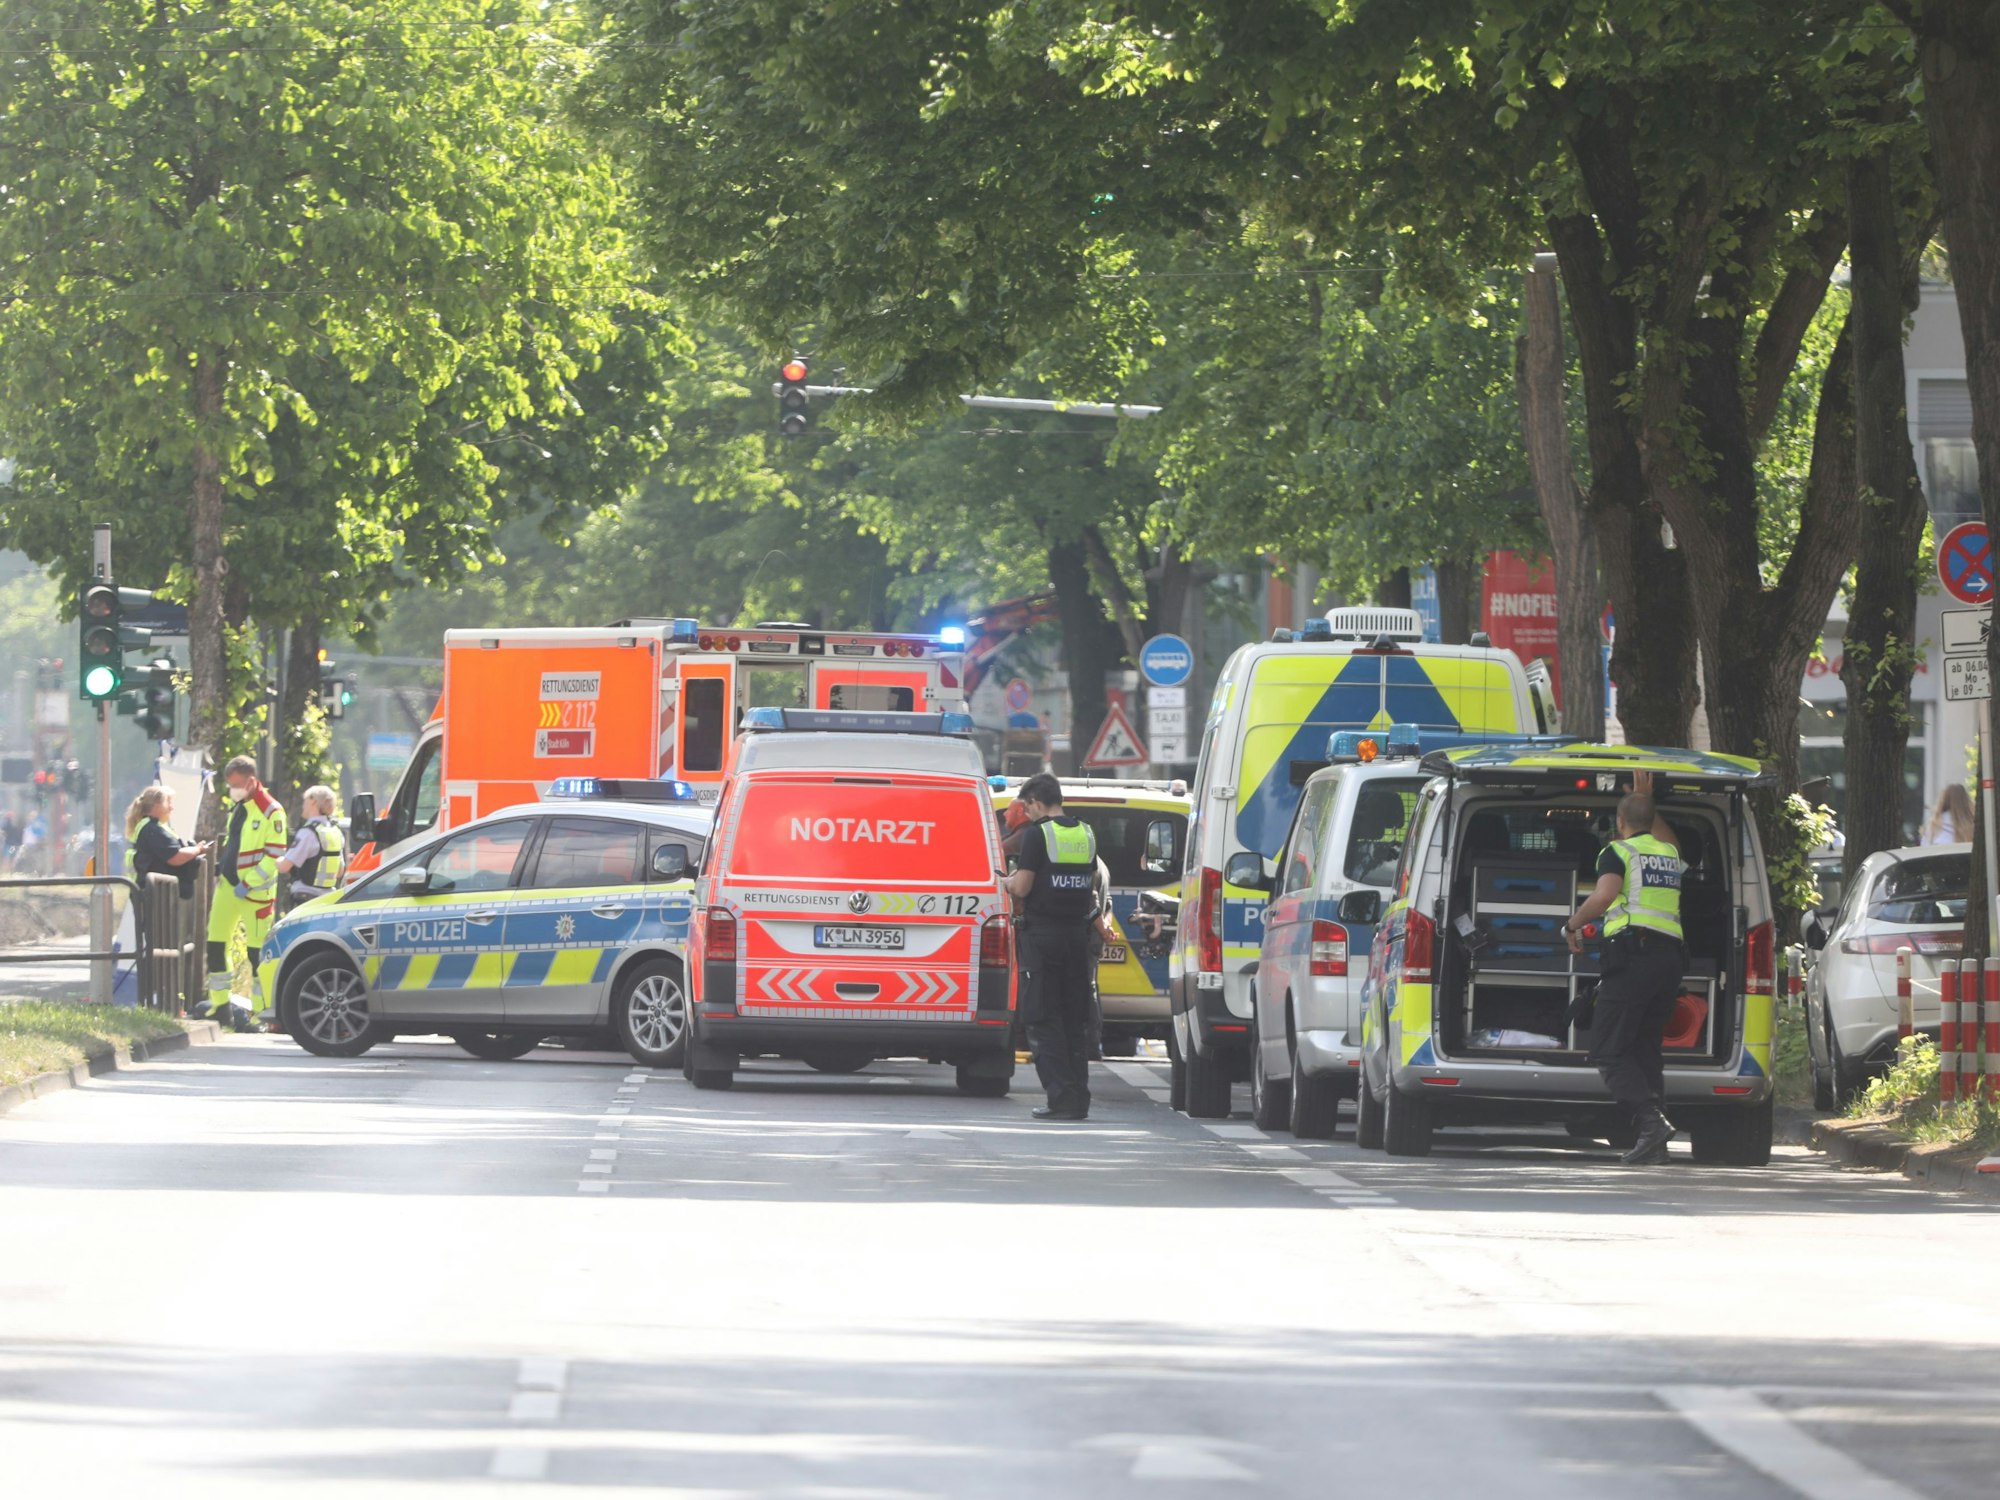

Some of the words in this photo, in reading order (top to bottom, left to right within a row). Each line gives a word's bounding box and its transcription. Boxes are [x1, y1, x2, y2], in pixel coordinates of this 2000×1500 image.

[1490, 592, 1557, 617] #NOFIL
[1952, 662, 1962, 673] ab
[542, 679, 599, 693] RETTUNGSDIENST
[1965, 673, 1977, 683] Mo
[1963, 684, 1973, 695] 09
[576, 701, 597, 728] 112
[790, 817, 937, 845] NOTARZT
[1051, 875, 1092, 888] VU-TEAM
[744, 893, 840, 906] RETTUNGSDIENST
[943, 895, 980, 915] 112
[394, 920, 467, 942] POLIZEI
[825, 928, 834, 942] K
[842, 929, 862, 943] LN
[865, 930, 901, 944] 3956
